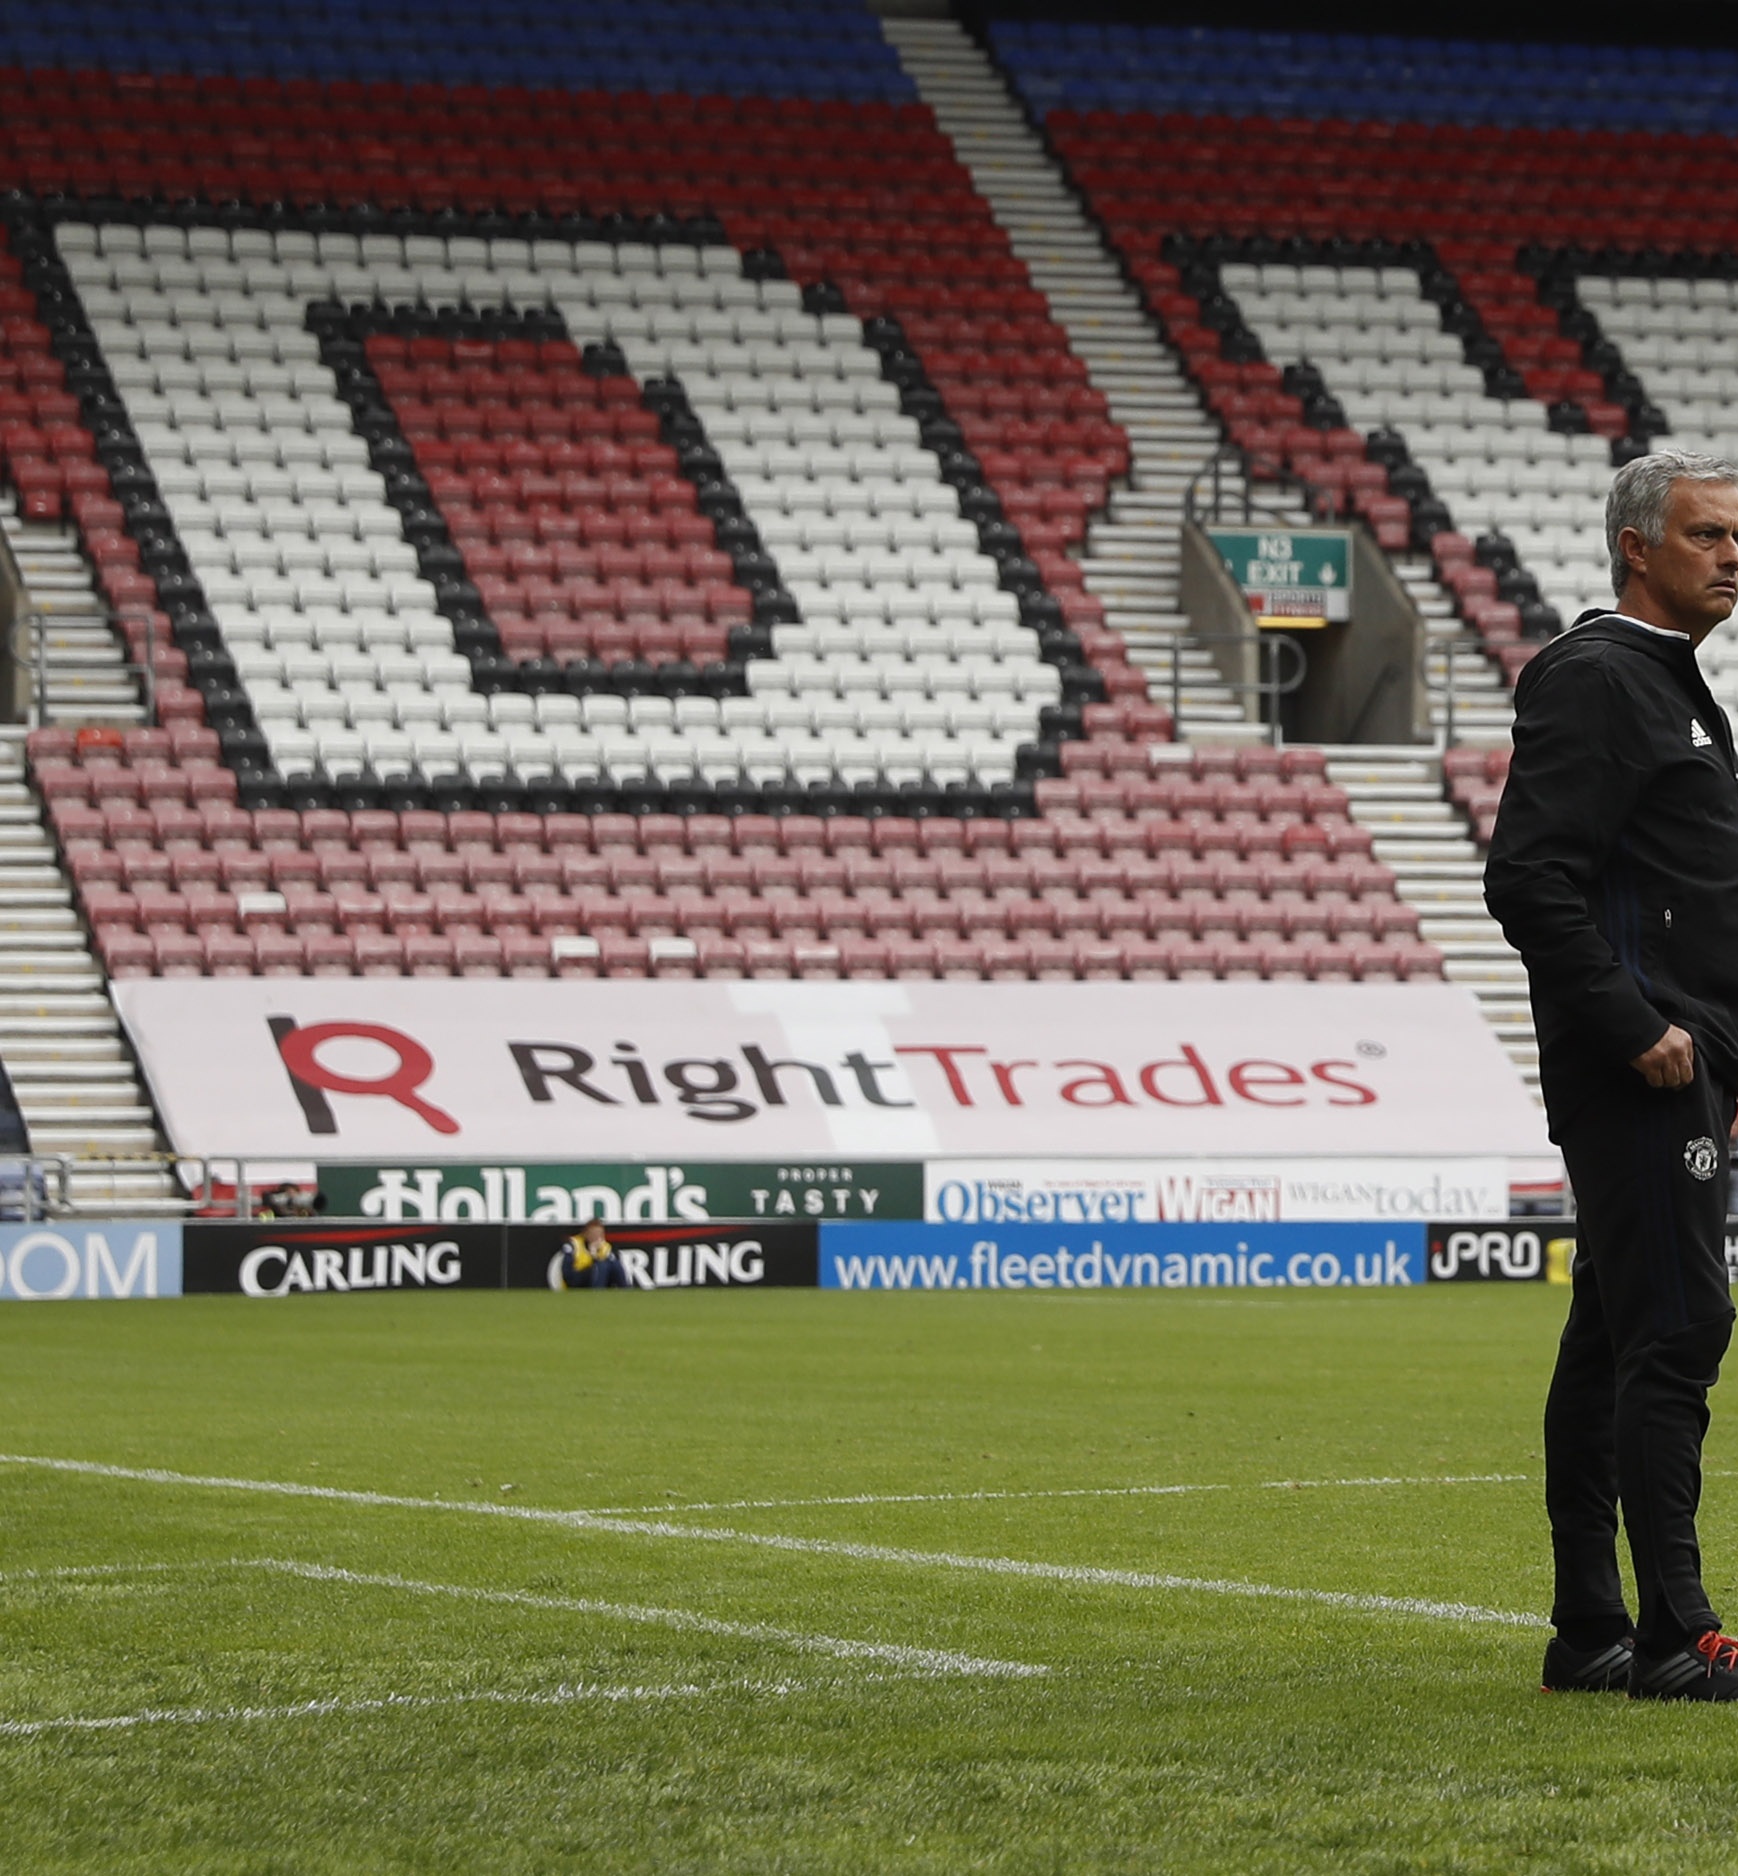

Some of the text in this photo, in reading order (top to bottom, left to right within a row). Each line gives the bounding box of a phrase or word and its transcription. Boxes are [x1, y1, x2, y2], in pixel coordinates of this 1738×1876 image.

[1247, 560, 1303, 584] EXIT
[507, 1040, 1378, 1122] RightTrades
[361, 1166, 710, 1222] Holland's
[777, 1168, 854, 1183] PROPER
[751, 1189, 880, 1215] TASTY
[937, 1180, 1146, 1222] Observer
[0, 1231, 158, 1300] OM
[239, 1241, 462, 1297] CARLING
[833, 1240, 1412, 1289] www.fleetdynamic.co.uk
